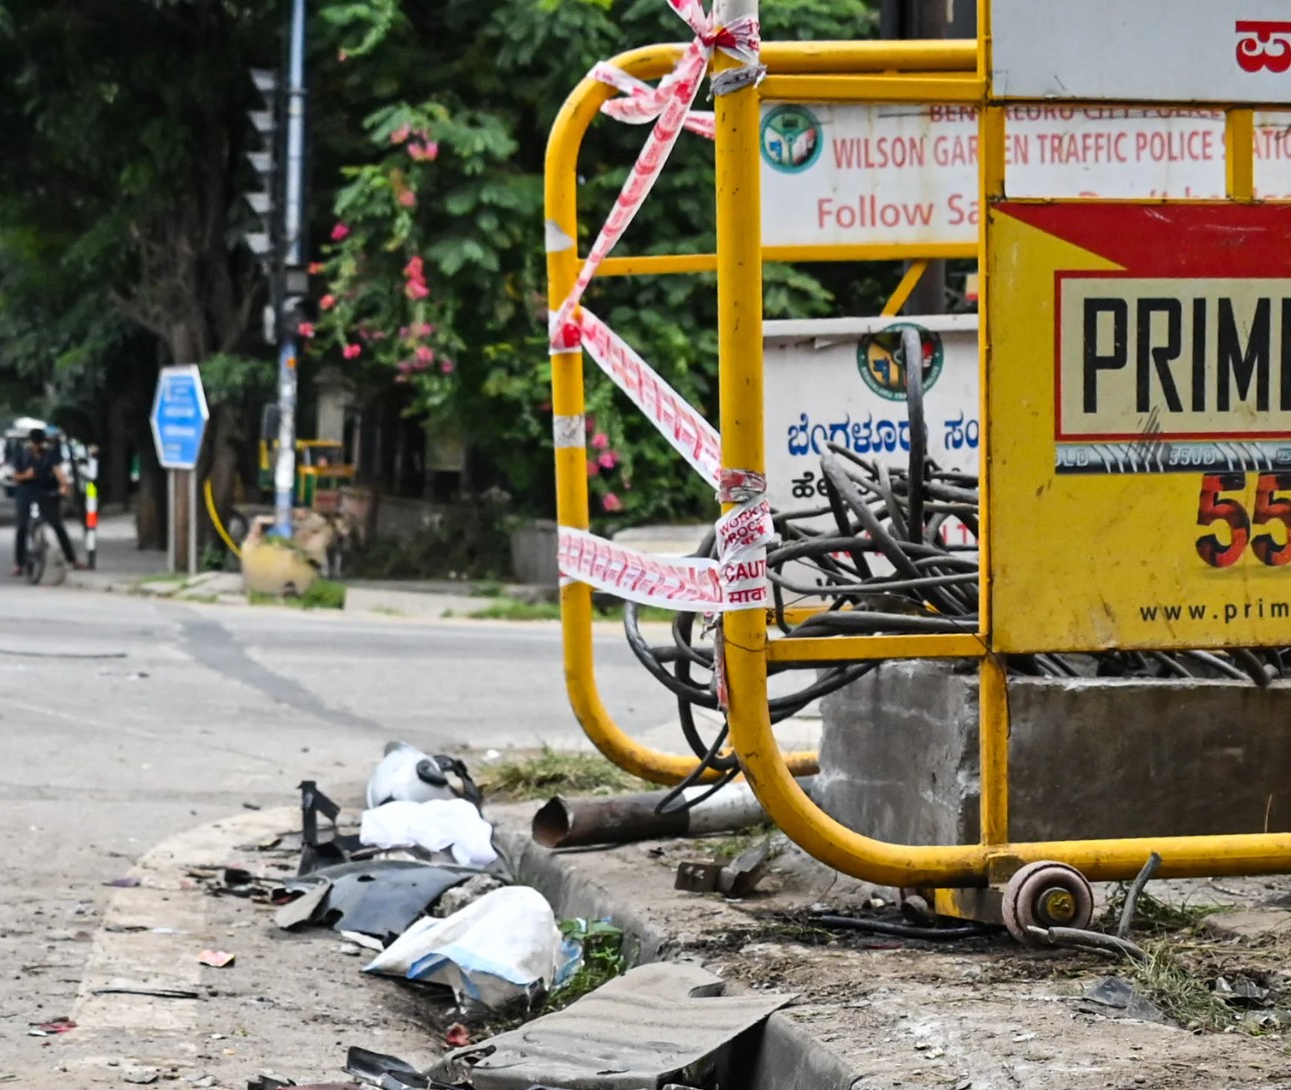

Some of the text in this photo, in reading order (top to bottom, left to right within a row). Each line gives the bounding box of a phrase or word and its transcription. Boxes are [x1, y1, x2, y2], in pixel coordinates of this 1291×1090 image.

[833, 136, 925, 169] WILSON
[934, 134, 1029, 168] GAREN
[1037, 131, 1127, 164] TRAFFIC
[1136, 130, 1213, 163] POLICE
[818, 194, 979, 230] Follow Sa
[788, 409, 979, 456] ಬೆಂಗಳೂರ ಸಂ
[724, 559, 767, 583] CAUT
